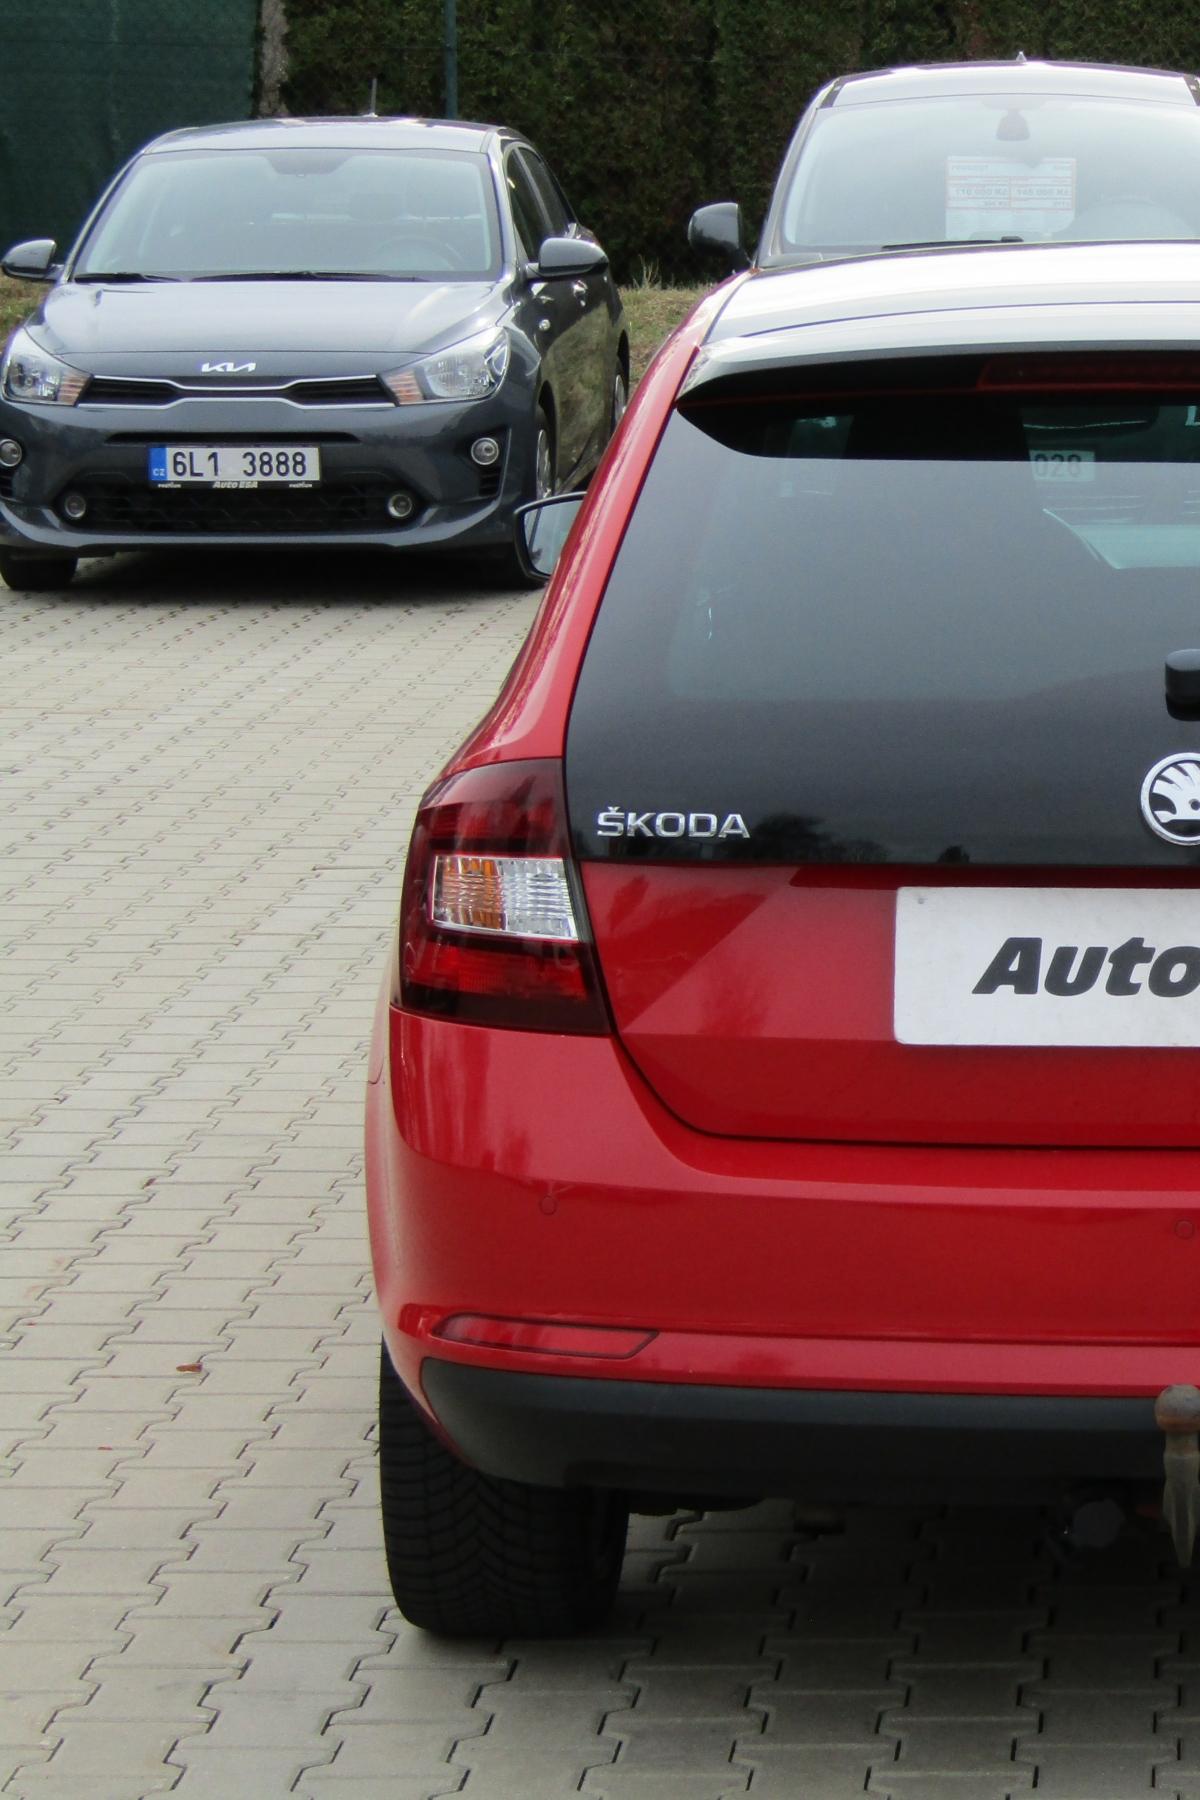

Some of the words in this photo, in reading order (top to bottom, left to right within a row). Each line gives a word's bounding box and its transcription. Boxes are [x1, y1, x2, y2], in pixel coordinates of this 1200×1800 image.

[201, 362, 257, 373] KIA
[152, 467, 165, 477] CZ
[173, 451, 219, 477] 6L1
[243, 451, 306, 477] 3888
[597, 806, 751, 839] ŠKODA
